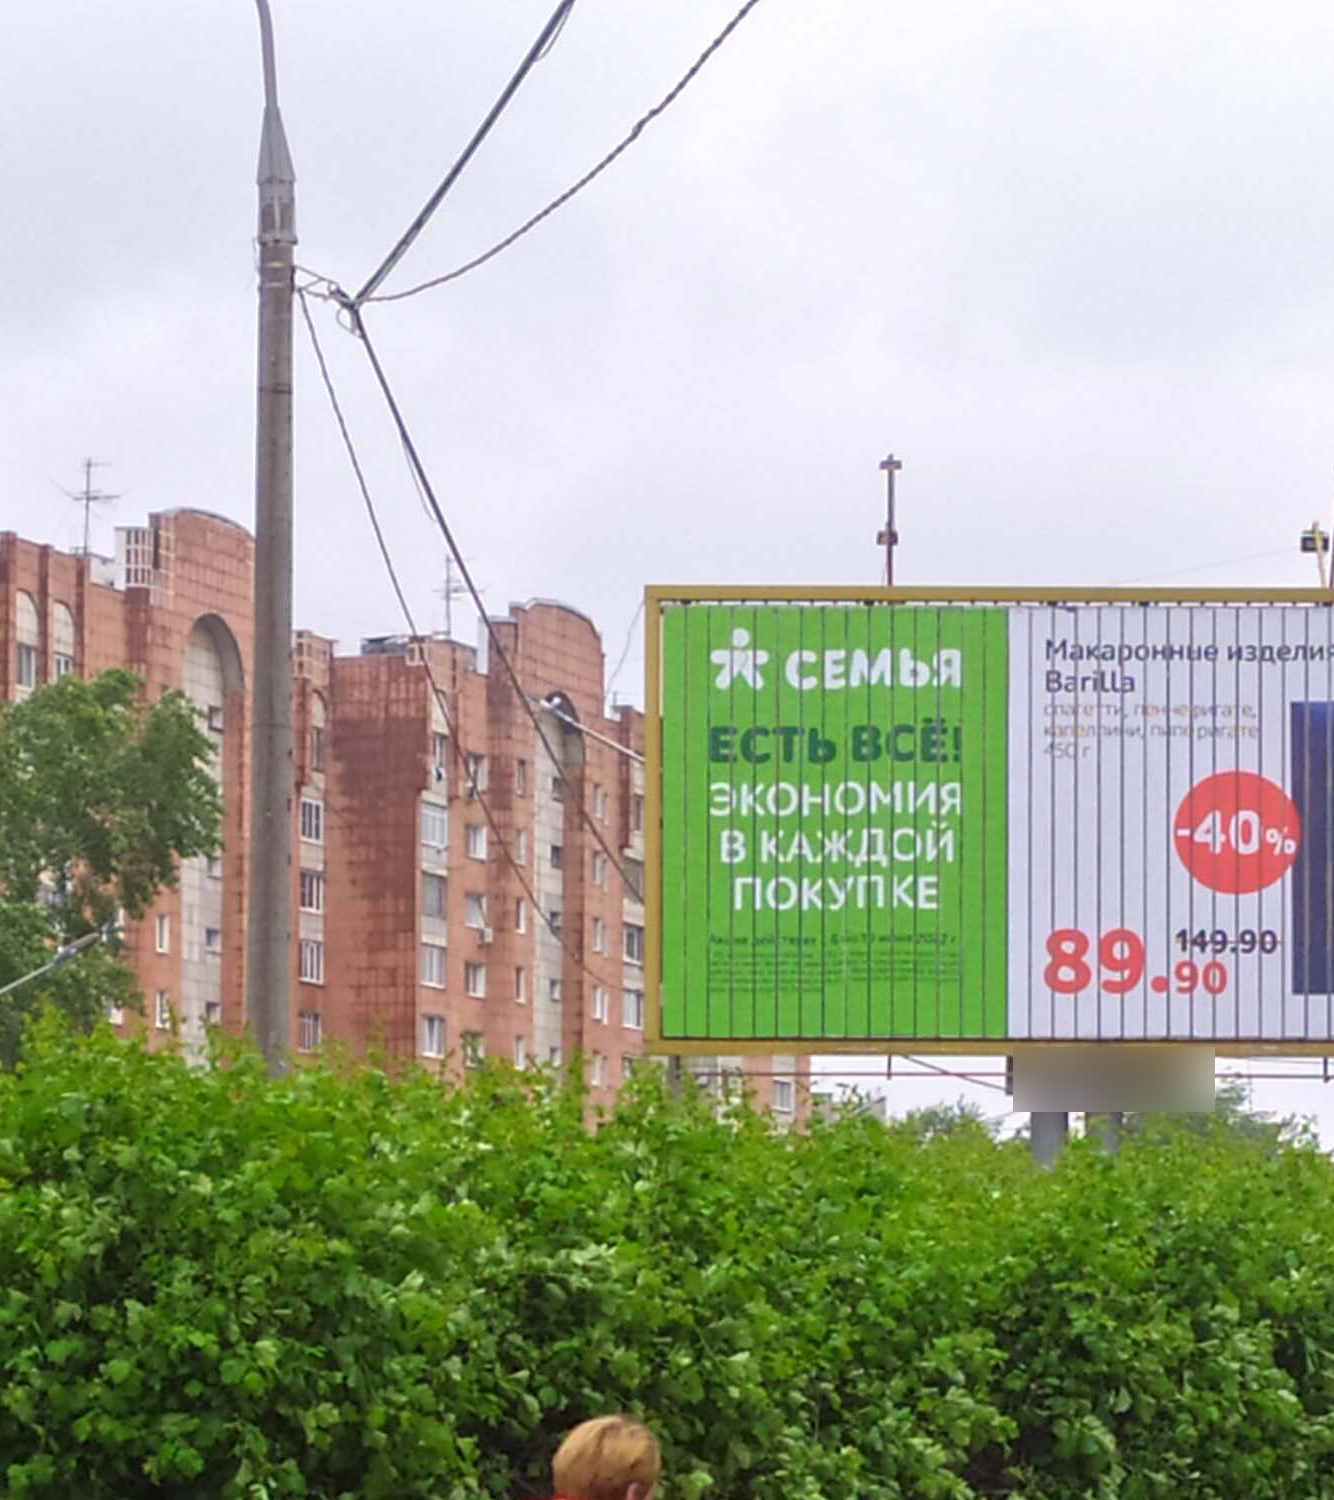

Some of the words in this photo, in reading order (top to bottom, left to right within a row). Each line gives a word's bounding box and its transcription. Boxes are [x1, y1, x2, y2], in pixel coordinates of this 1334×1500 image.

[785, 648, 962, 690] СЕМЬЯ
[1045, 639, 1218, 665] Макаронные
[1045, 670, 1135, 693] Barilla
[709, 726, 836, 764] ЕСТЬ
[852, 717, 962, 763] ВСЁ!
[710, 782, 962, 816] ЭКОНОМИЯ
[720, 829, 747, 864] В
[761, 821, 955, 868] КАЖДОЙ
[1176, 809, 1297, 855] -40%
[734, 875, 940, 911] ПОКУПКЕ
[1175, 928, 1279, 954] 149.90
